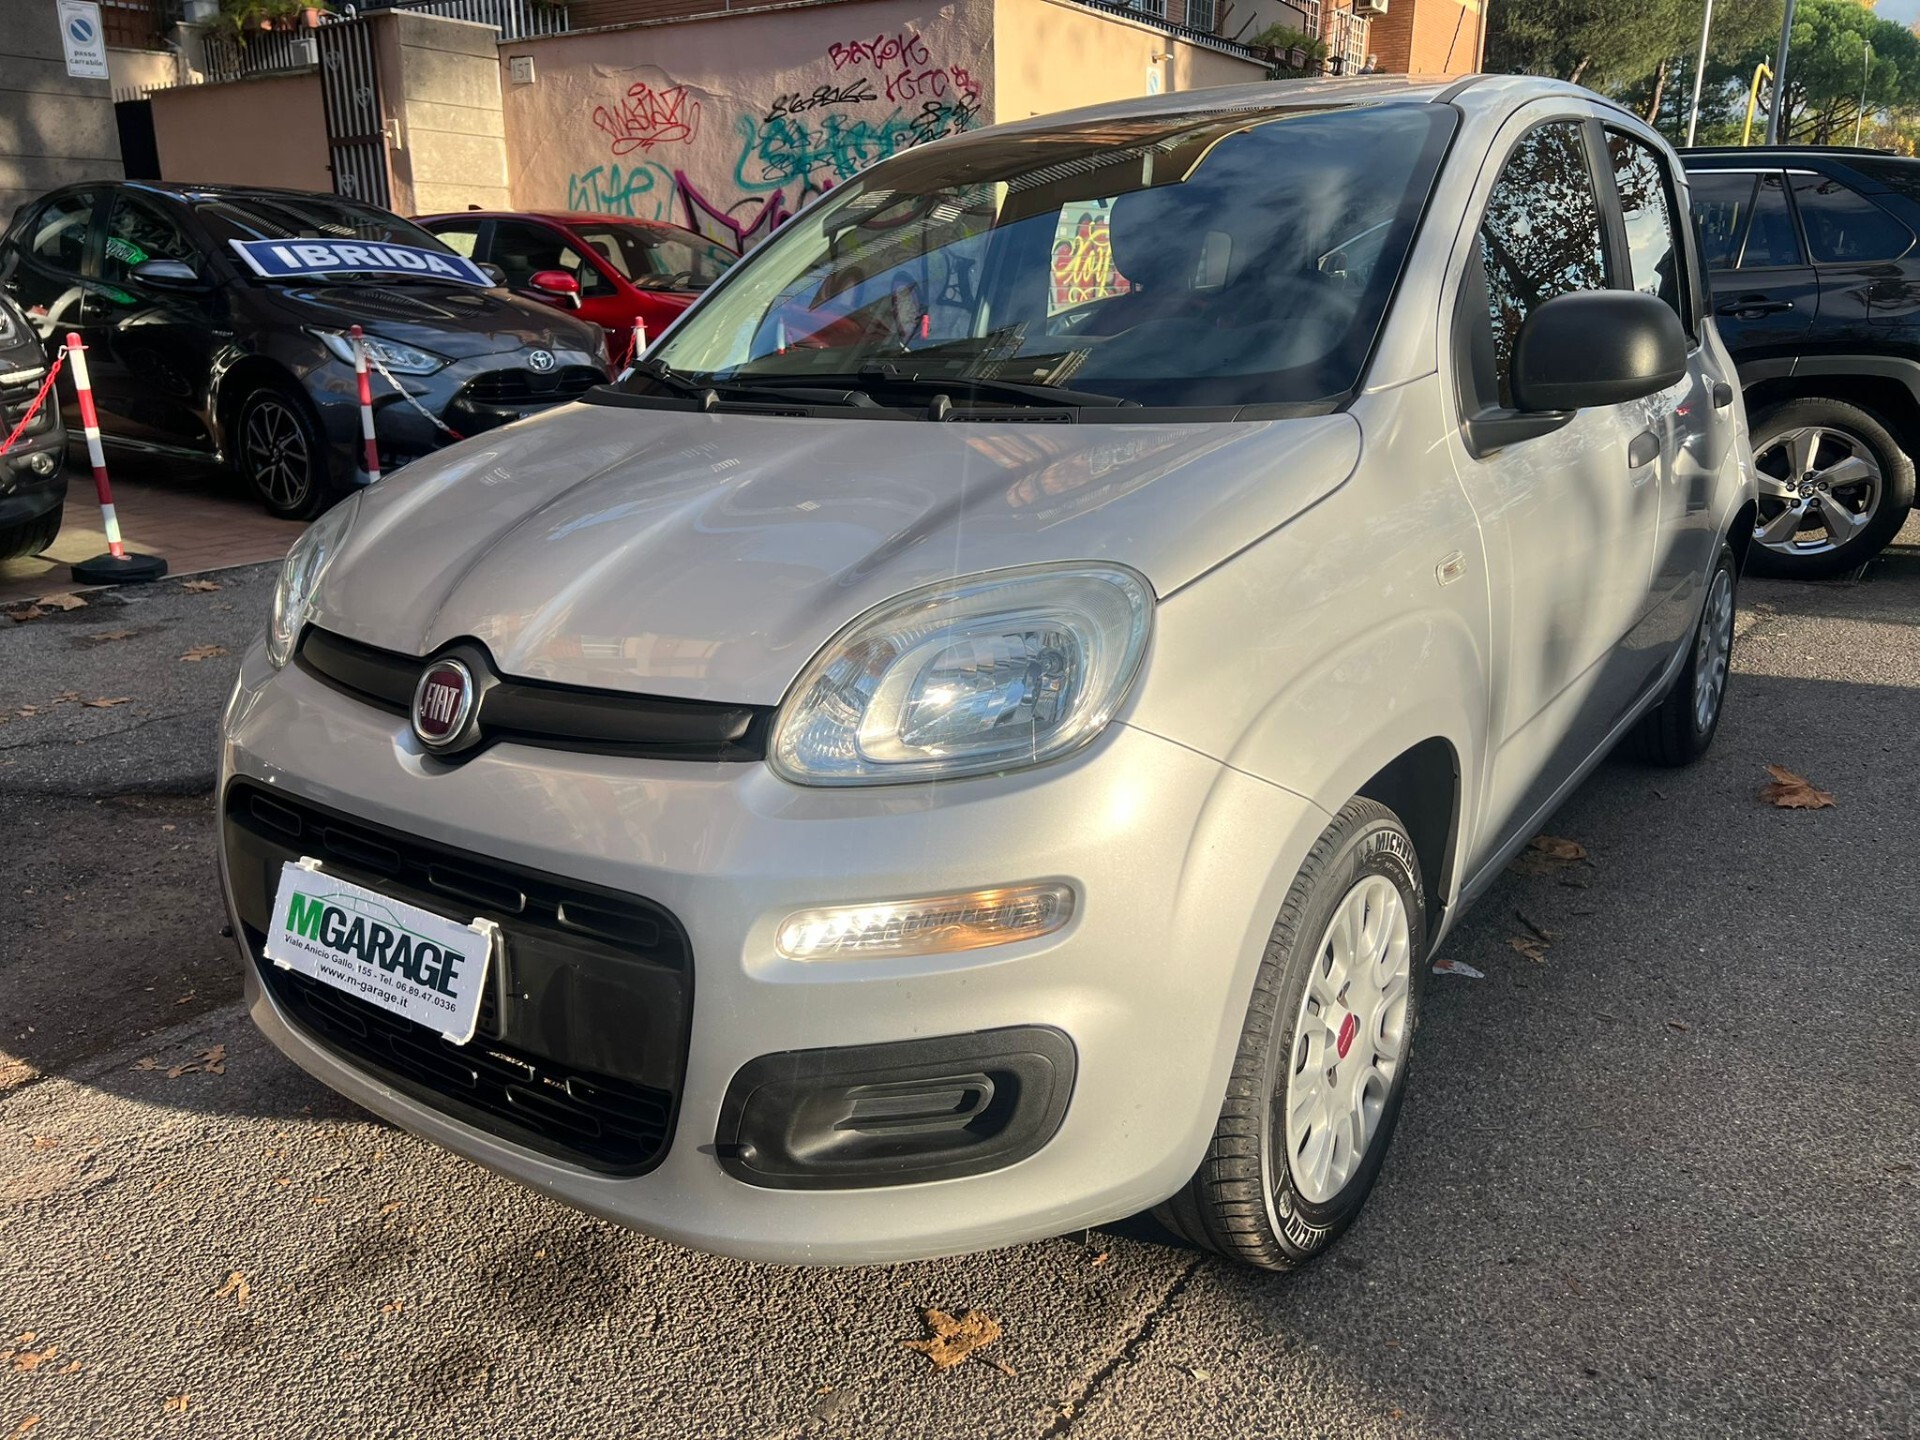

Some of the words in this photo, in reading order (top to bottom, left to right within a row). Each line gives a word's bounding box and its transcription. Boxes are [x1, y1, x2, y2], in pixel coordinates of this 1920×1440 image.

[74, 50, 97, 58] passo
[271, 245, 464, 277] IBRIDA
[422, 682, 460, 724] FIAT
[286, 892, 466, 1000] MGARAGE
[285, 934, 303, 949] Viale
[304, 943, 330, 960] Anicio
[331, 954, 356, 972] Gallo,
[357, 965, 373, 978] 155
[379, 973, 394, 987] Tel.
[395, 980, 457, 1013] 06.89.47.0336
[320, 963, 409, 1008] www.m-garage.it
